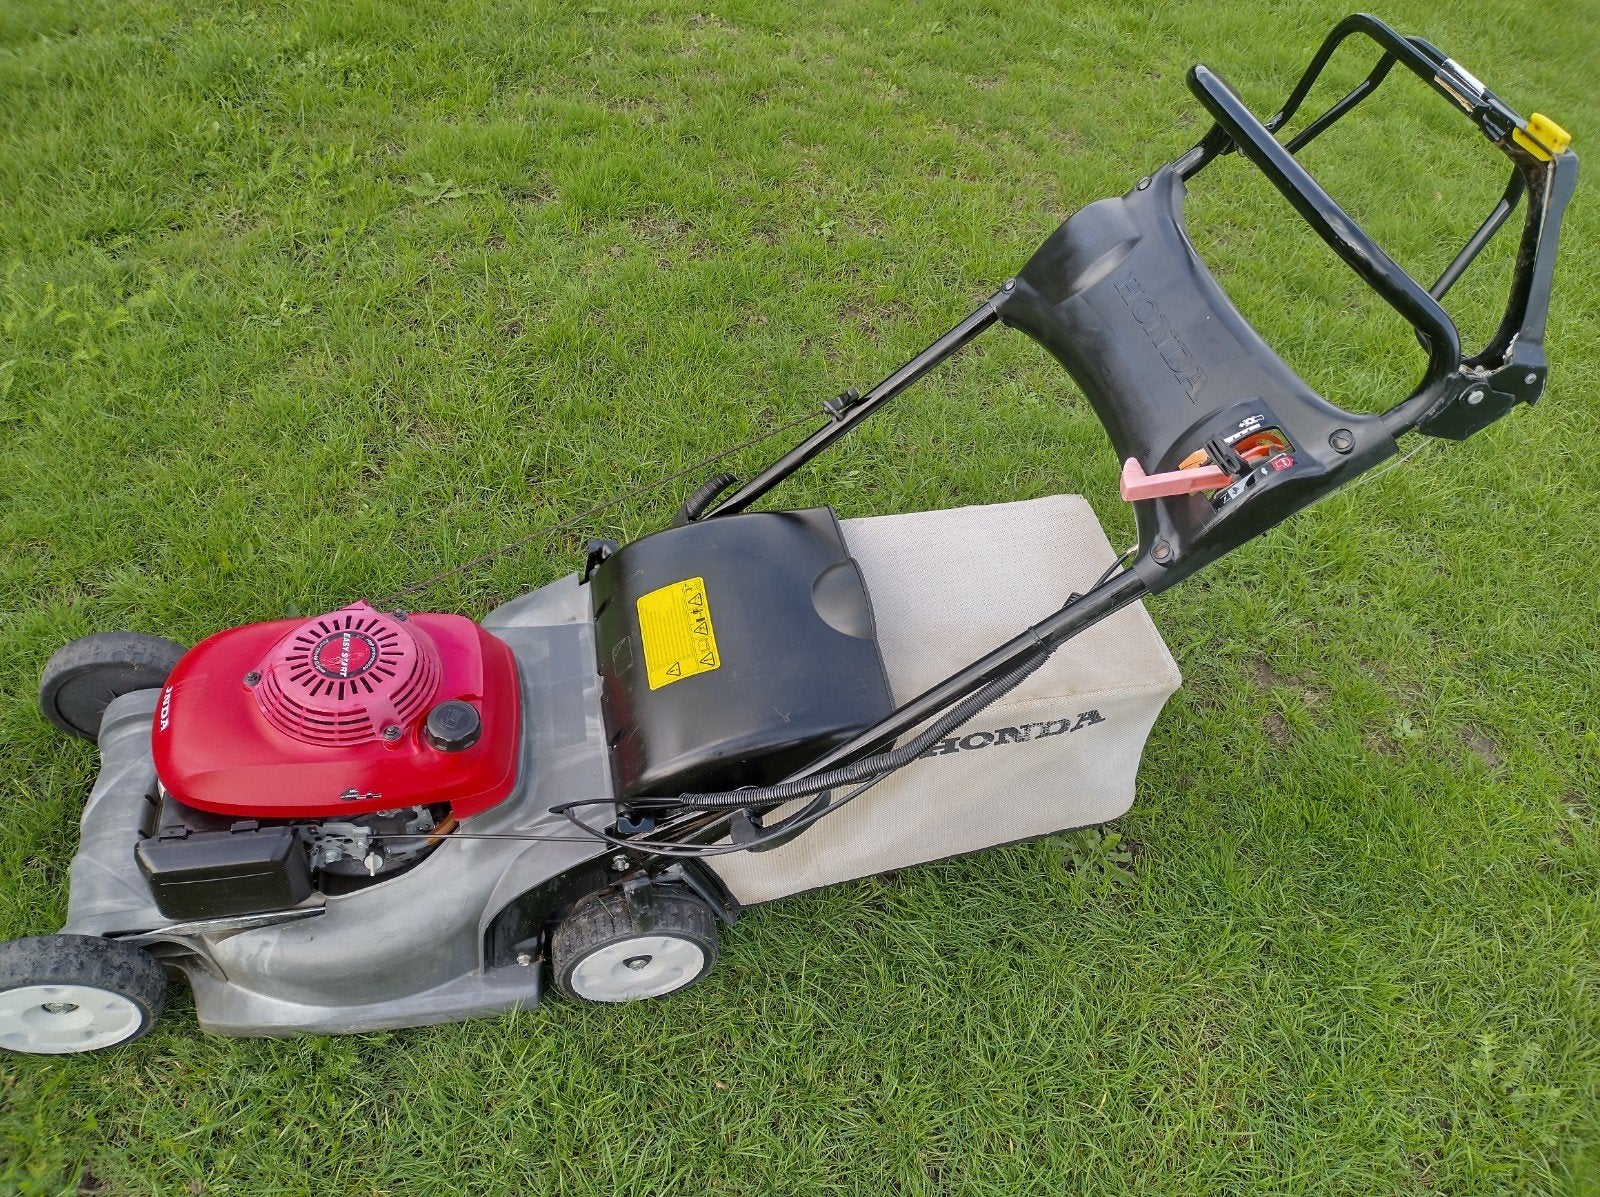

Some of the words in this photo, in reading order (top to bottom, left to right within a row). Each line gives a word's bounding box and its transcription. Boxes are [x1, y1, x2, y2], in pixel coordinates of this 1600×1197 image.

[1112, 274, 1208, 405] HONDA
[342, 633, 351, 651] EASY
[340, 653, 349, 677] START
[918, 709, 1106, 760] HONDA
